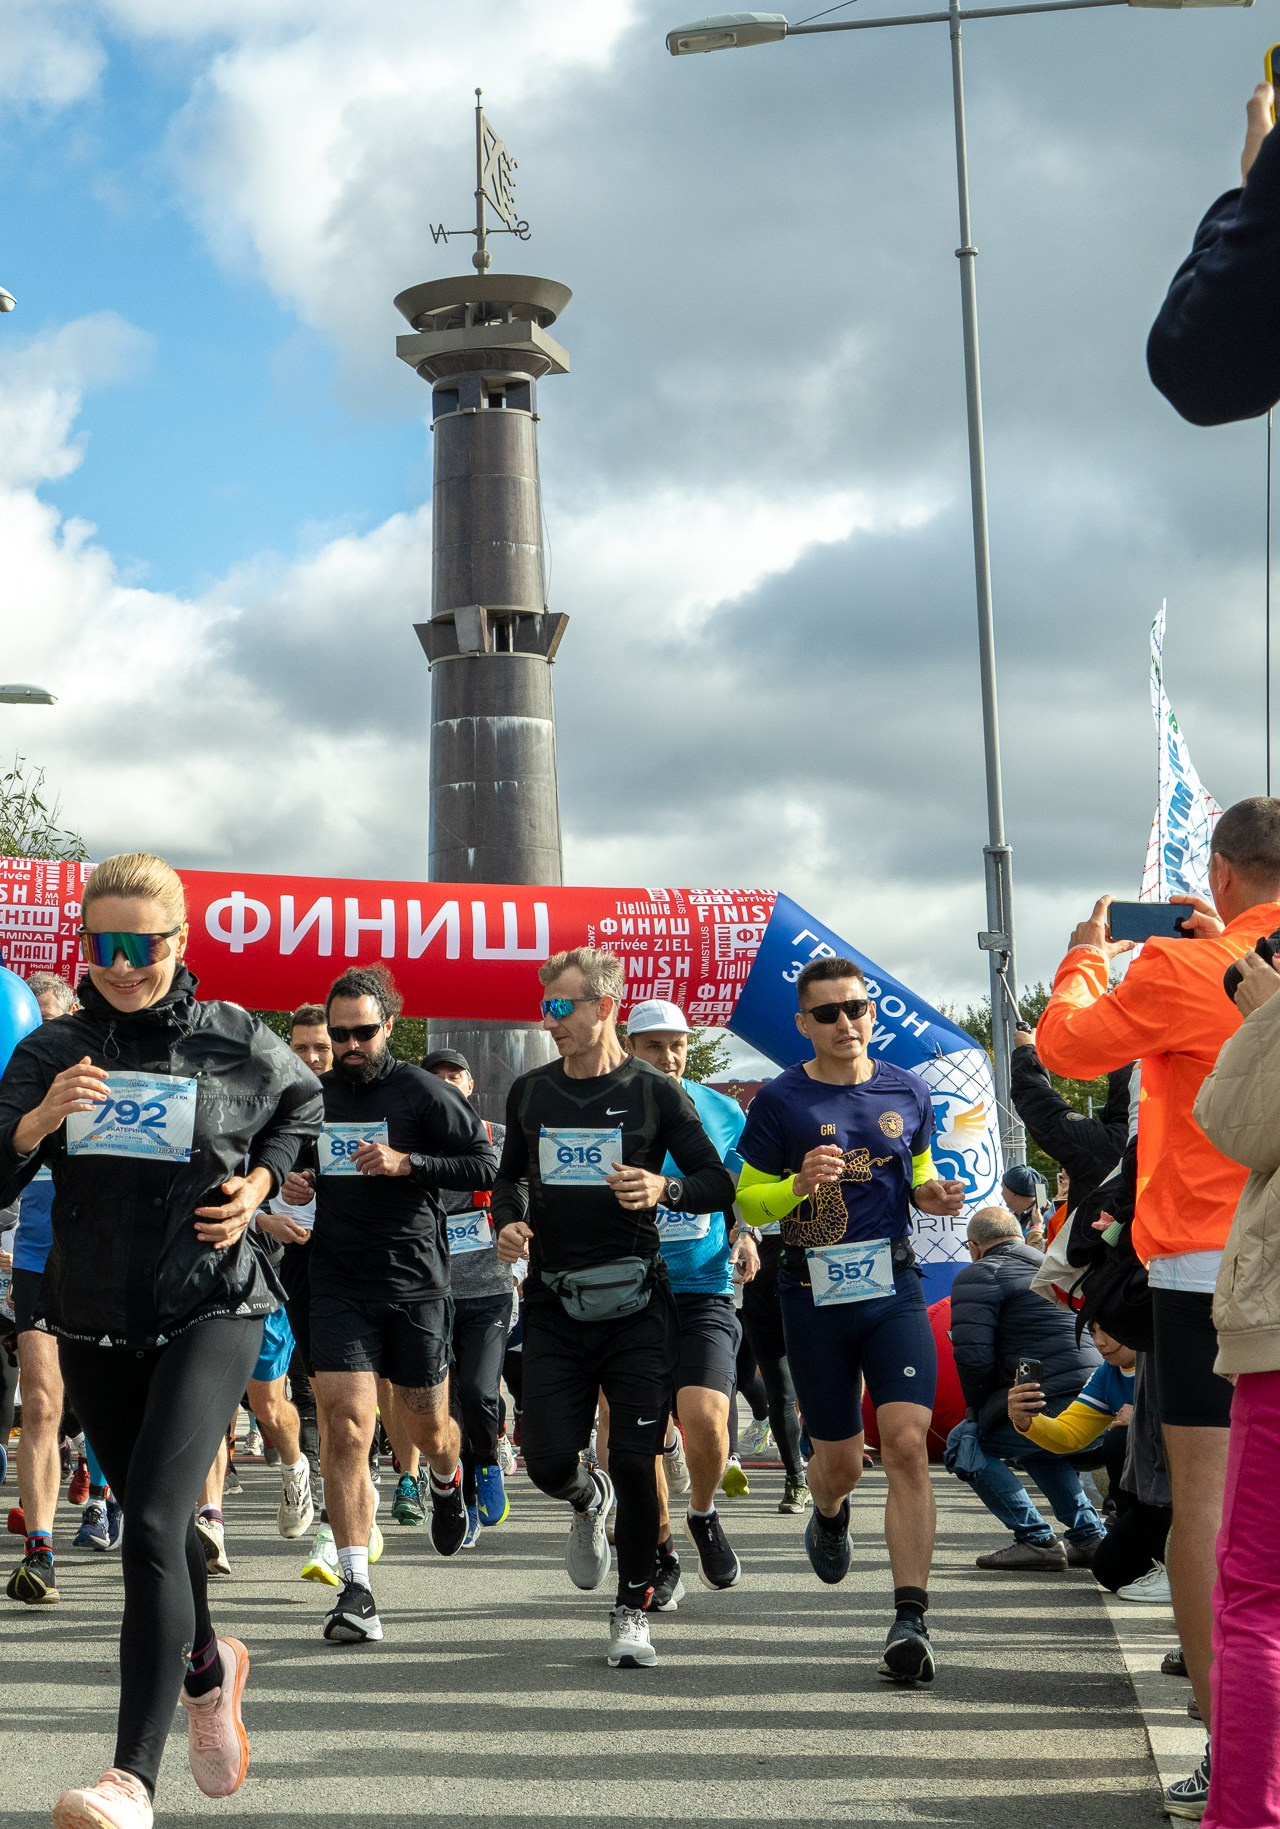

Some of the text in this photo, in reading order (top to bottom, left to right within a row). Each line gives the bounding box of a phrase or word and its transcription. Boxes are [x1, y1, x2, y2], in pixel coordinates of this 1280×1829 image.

[615, 901, 671, 915] Ziellinie
[205, 891, 550, 960] ФИНИШ
[600, 917, 690, 935] ФИНИШ
[14, 944, 53, 961] MAALI
[601, 938, 693, 952] arrivée ZIEL
[700, 926, 710, 979] VIIMISTLUS
[716, 961, 751, 980] Zielli
[791, 928, 931, 1038] ГРФОН
[692, 1003, 730, 1013] ZIEL
[91, 1100, 167, 1128] 792
[106, 1126, 148, 1134] ЕКАТЕРИНА
[331, 1140, 373, 1156] 88
[557, 1146, 602, 1163] 616
[828, 1259, 875, 1281] 557
